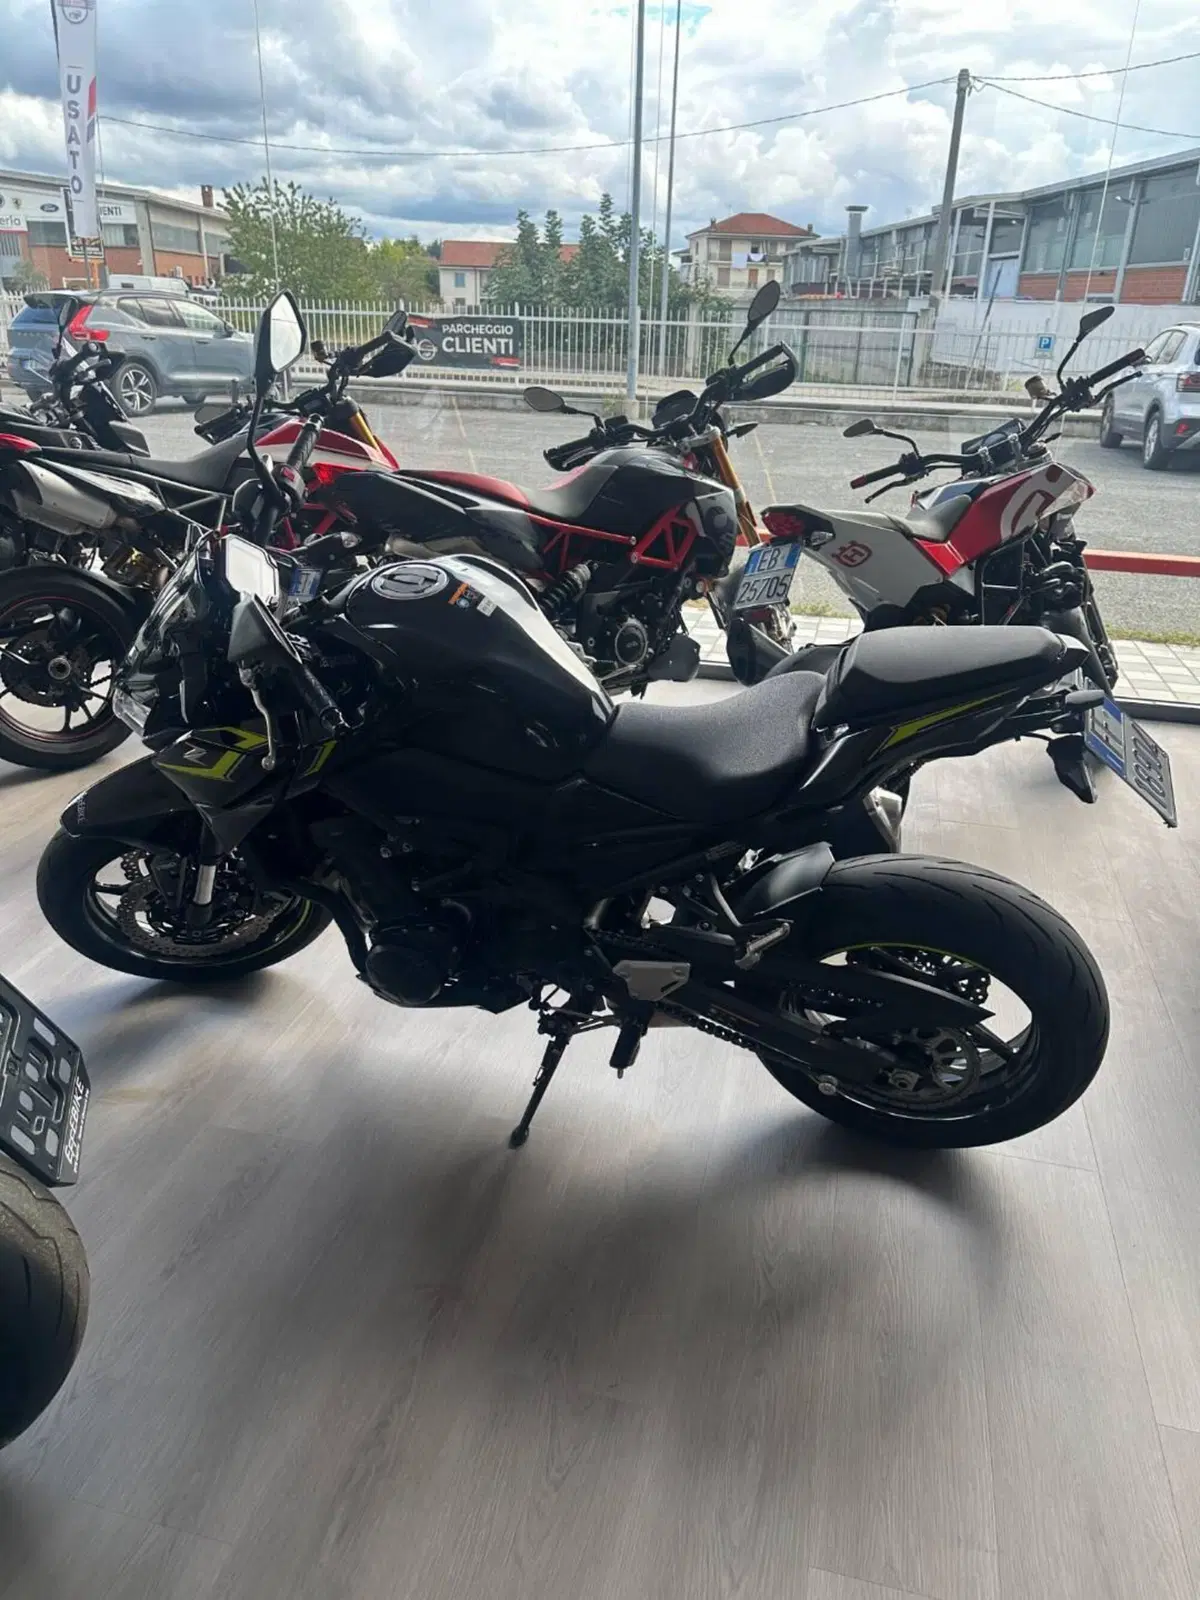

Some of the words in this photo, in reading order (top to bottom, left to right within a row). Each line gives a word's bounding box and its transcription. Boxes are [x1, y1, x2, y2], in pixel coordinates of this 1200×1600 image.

[67, 74, 82, 194] USATO
[442, 324, 514, 335] PARCHEGGIO
[441, 336, 514, 355] CLIENTI
[757, 548, 781, 571] EB
[736, 574, 791, 604] 25705
